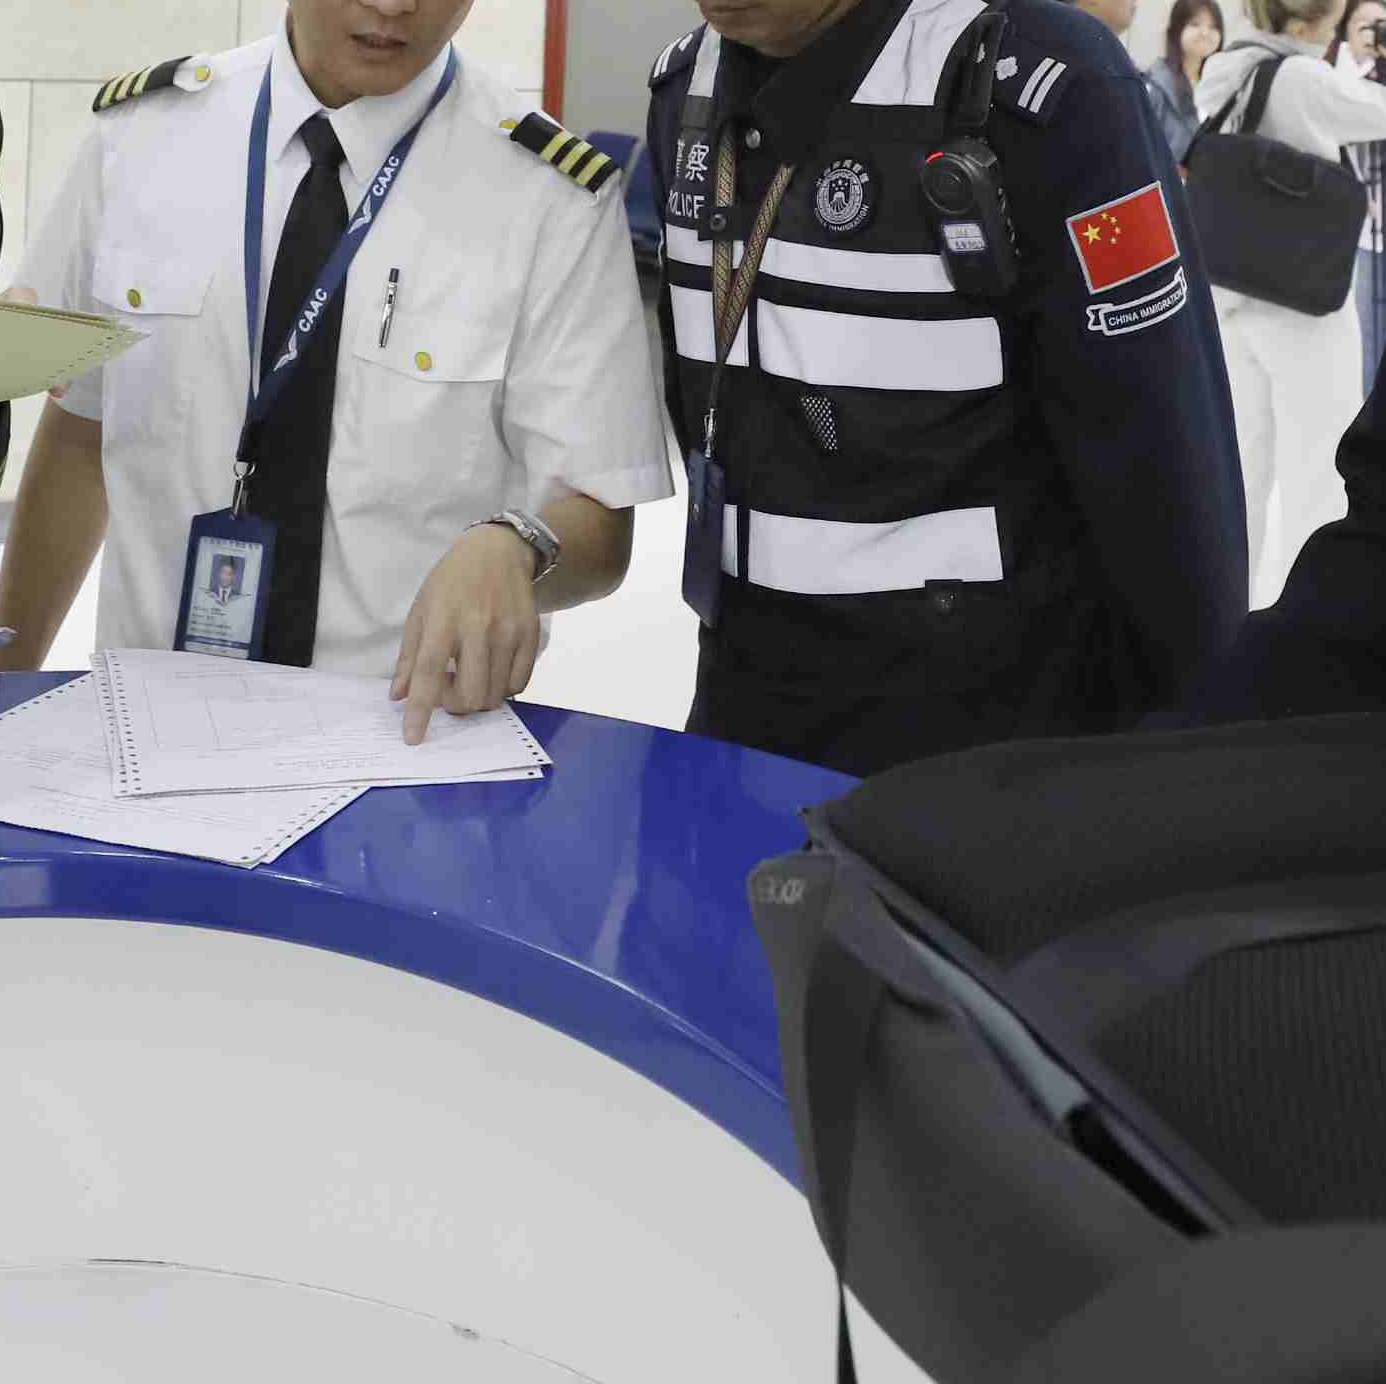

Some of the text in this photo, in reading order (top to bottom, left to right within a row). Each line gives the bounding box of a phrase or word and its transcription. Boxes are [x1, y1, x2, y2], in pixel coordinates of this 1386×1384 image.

[372, 156, 400, 197] CAAC
[298, 288, 328, 332] CAAC
[1108, 311, 1139, 327] CHINA
